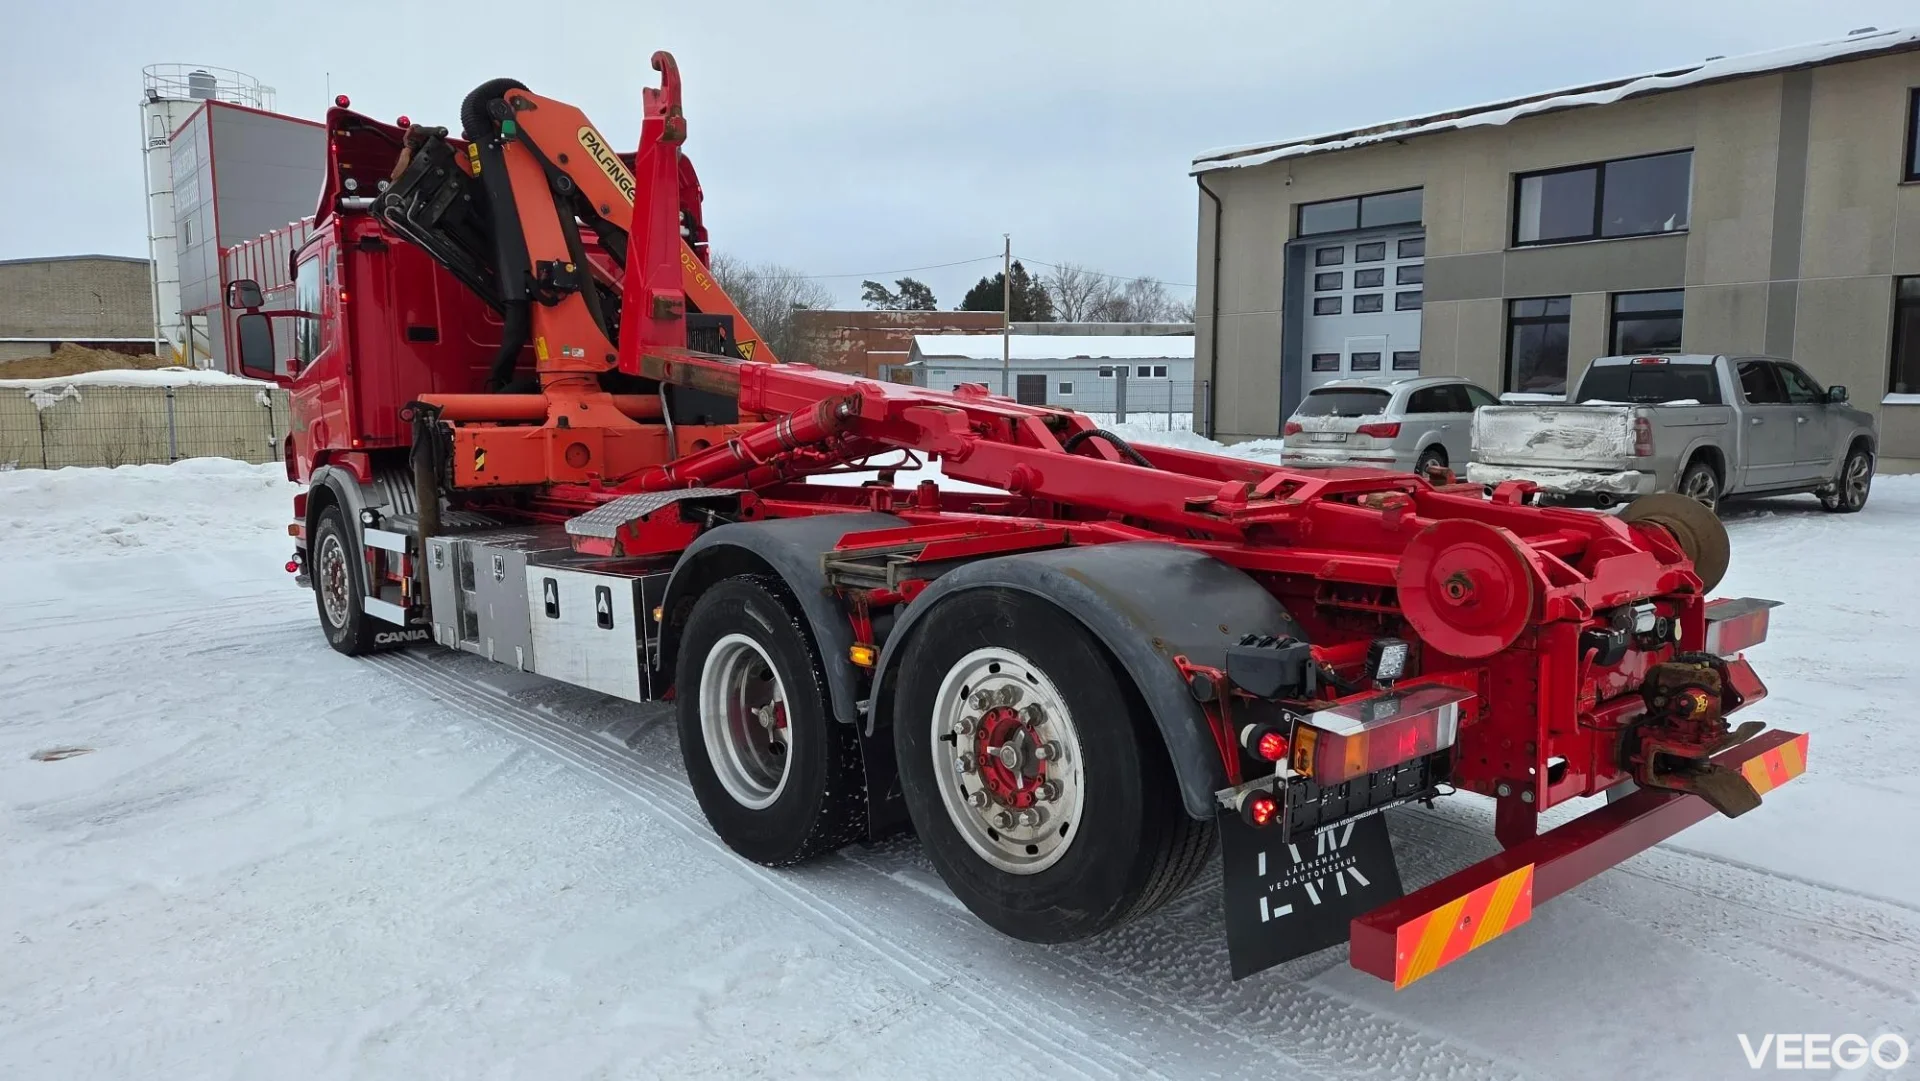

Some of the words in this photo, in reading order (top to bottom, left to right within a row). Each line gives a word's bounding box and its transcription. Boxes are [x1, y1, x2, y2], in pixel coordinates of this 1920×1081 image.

[581, 131, 637, 201] PALFINGE
[374, 630, 430, 644] CANIA
[1269, 855, 1357, 892] VEOAUTOKESKUS
